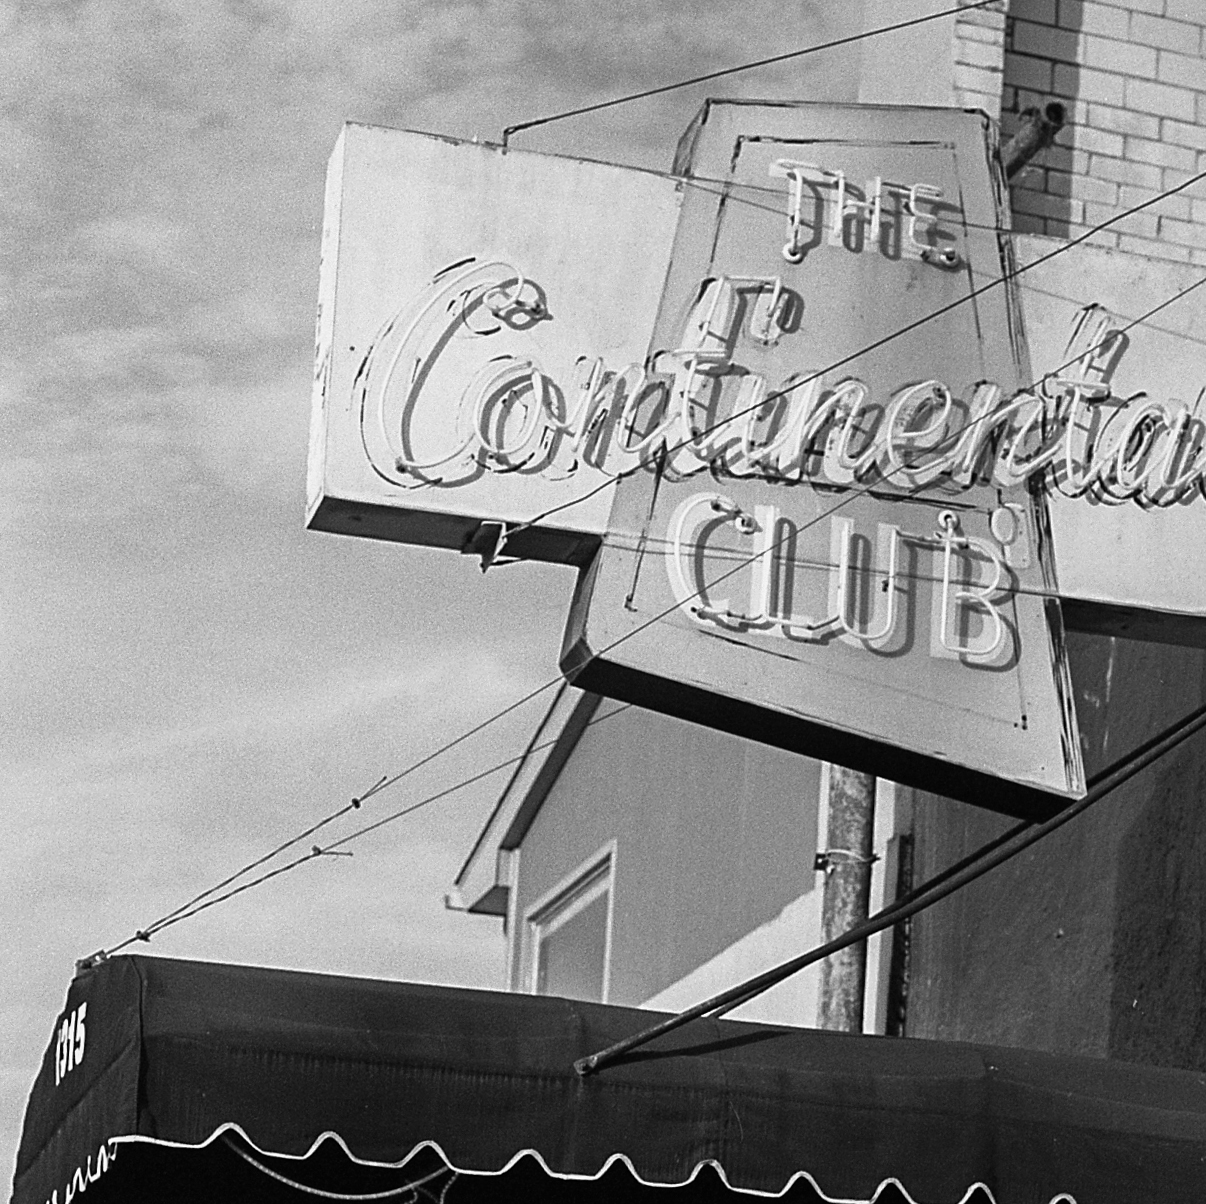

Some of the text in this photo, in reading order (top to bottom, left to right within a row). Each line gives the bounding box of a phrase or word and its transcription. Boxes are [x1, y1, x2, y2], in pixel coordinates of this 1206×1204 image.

[769, 157, 957, 263] THE
[665, 491, 1018, 662] CLUB
[54, 1001, 88, 1086] 1315
